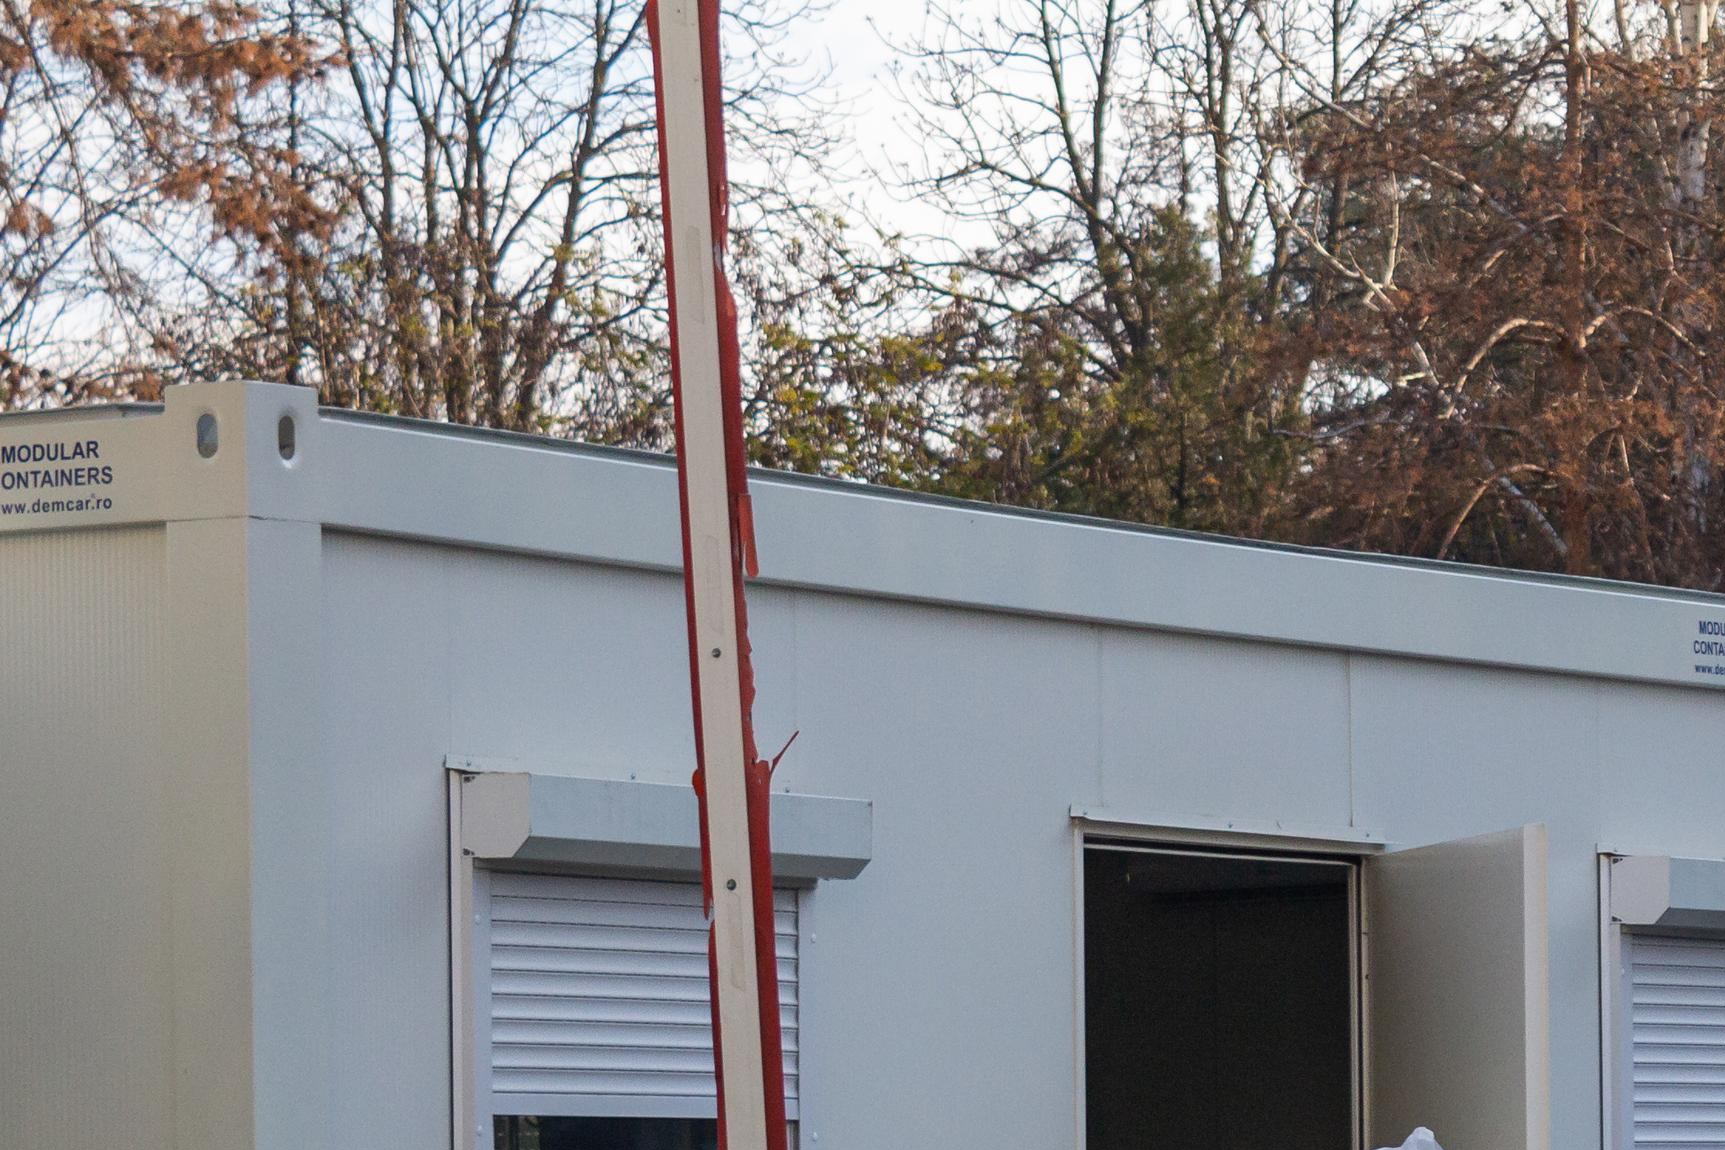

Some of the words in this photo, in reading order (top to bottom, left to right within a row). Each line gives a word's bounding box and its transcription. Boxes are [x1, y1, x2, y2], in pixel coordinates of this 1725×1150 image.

[1, 440, 100, 464] MODULAR
[1, 465, 113, 490] ONTAINERS
[1, 497, 112, 514] ww.demcar.ro
